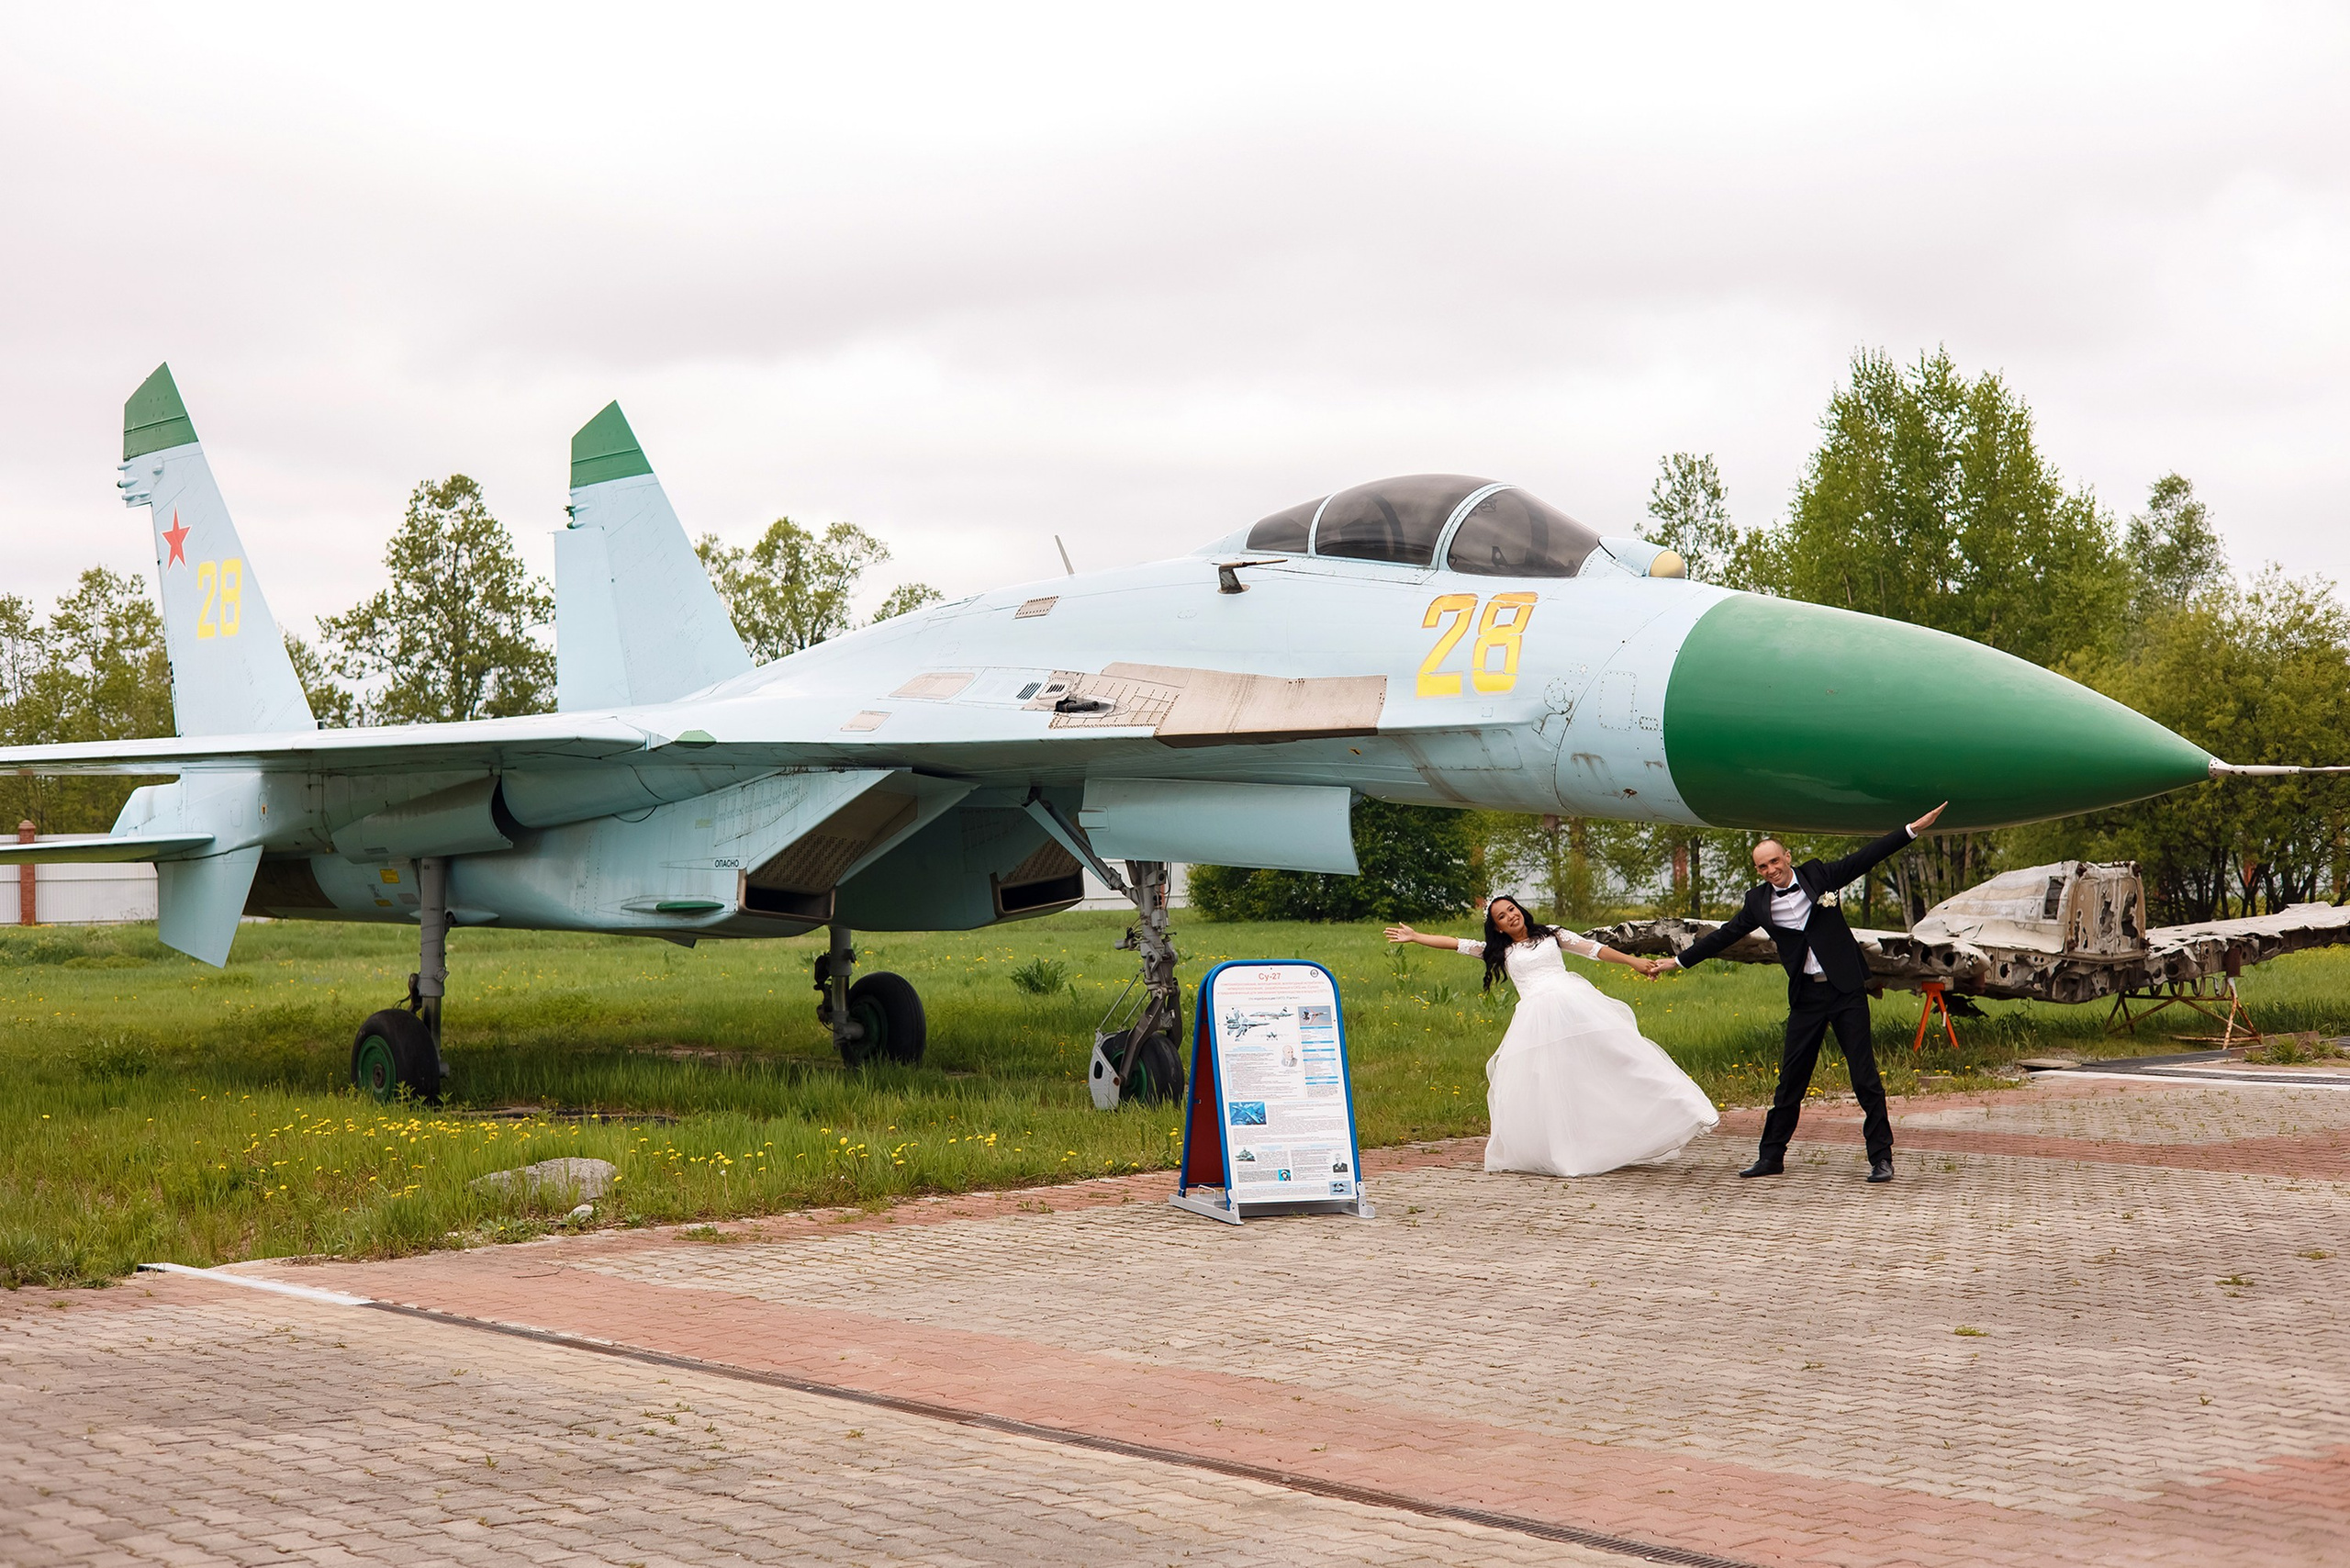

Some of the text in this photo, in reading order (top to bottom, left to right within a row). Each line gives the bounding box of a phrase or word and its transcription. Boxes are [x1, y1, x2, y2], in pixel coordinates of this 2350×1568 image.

[197, 558, 242, 639] 28
[1416, 591, 1539, 700] 28
[714, 859, 739, 868] ОПАСНО
[1259, 972, 1281, 981] Су-27
